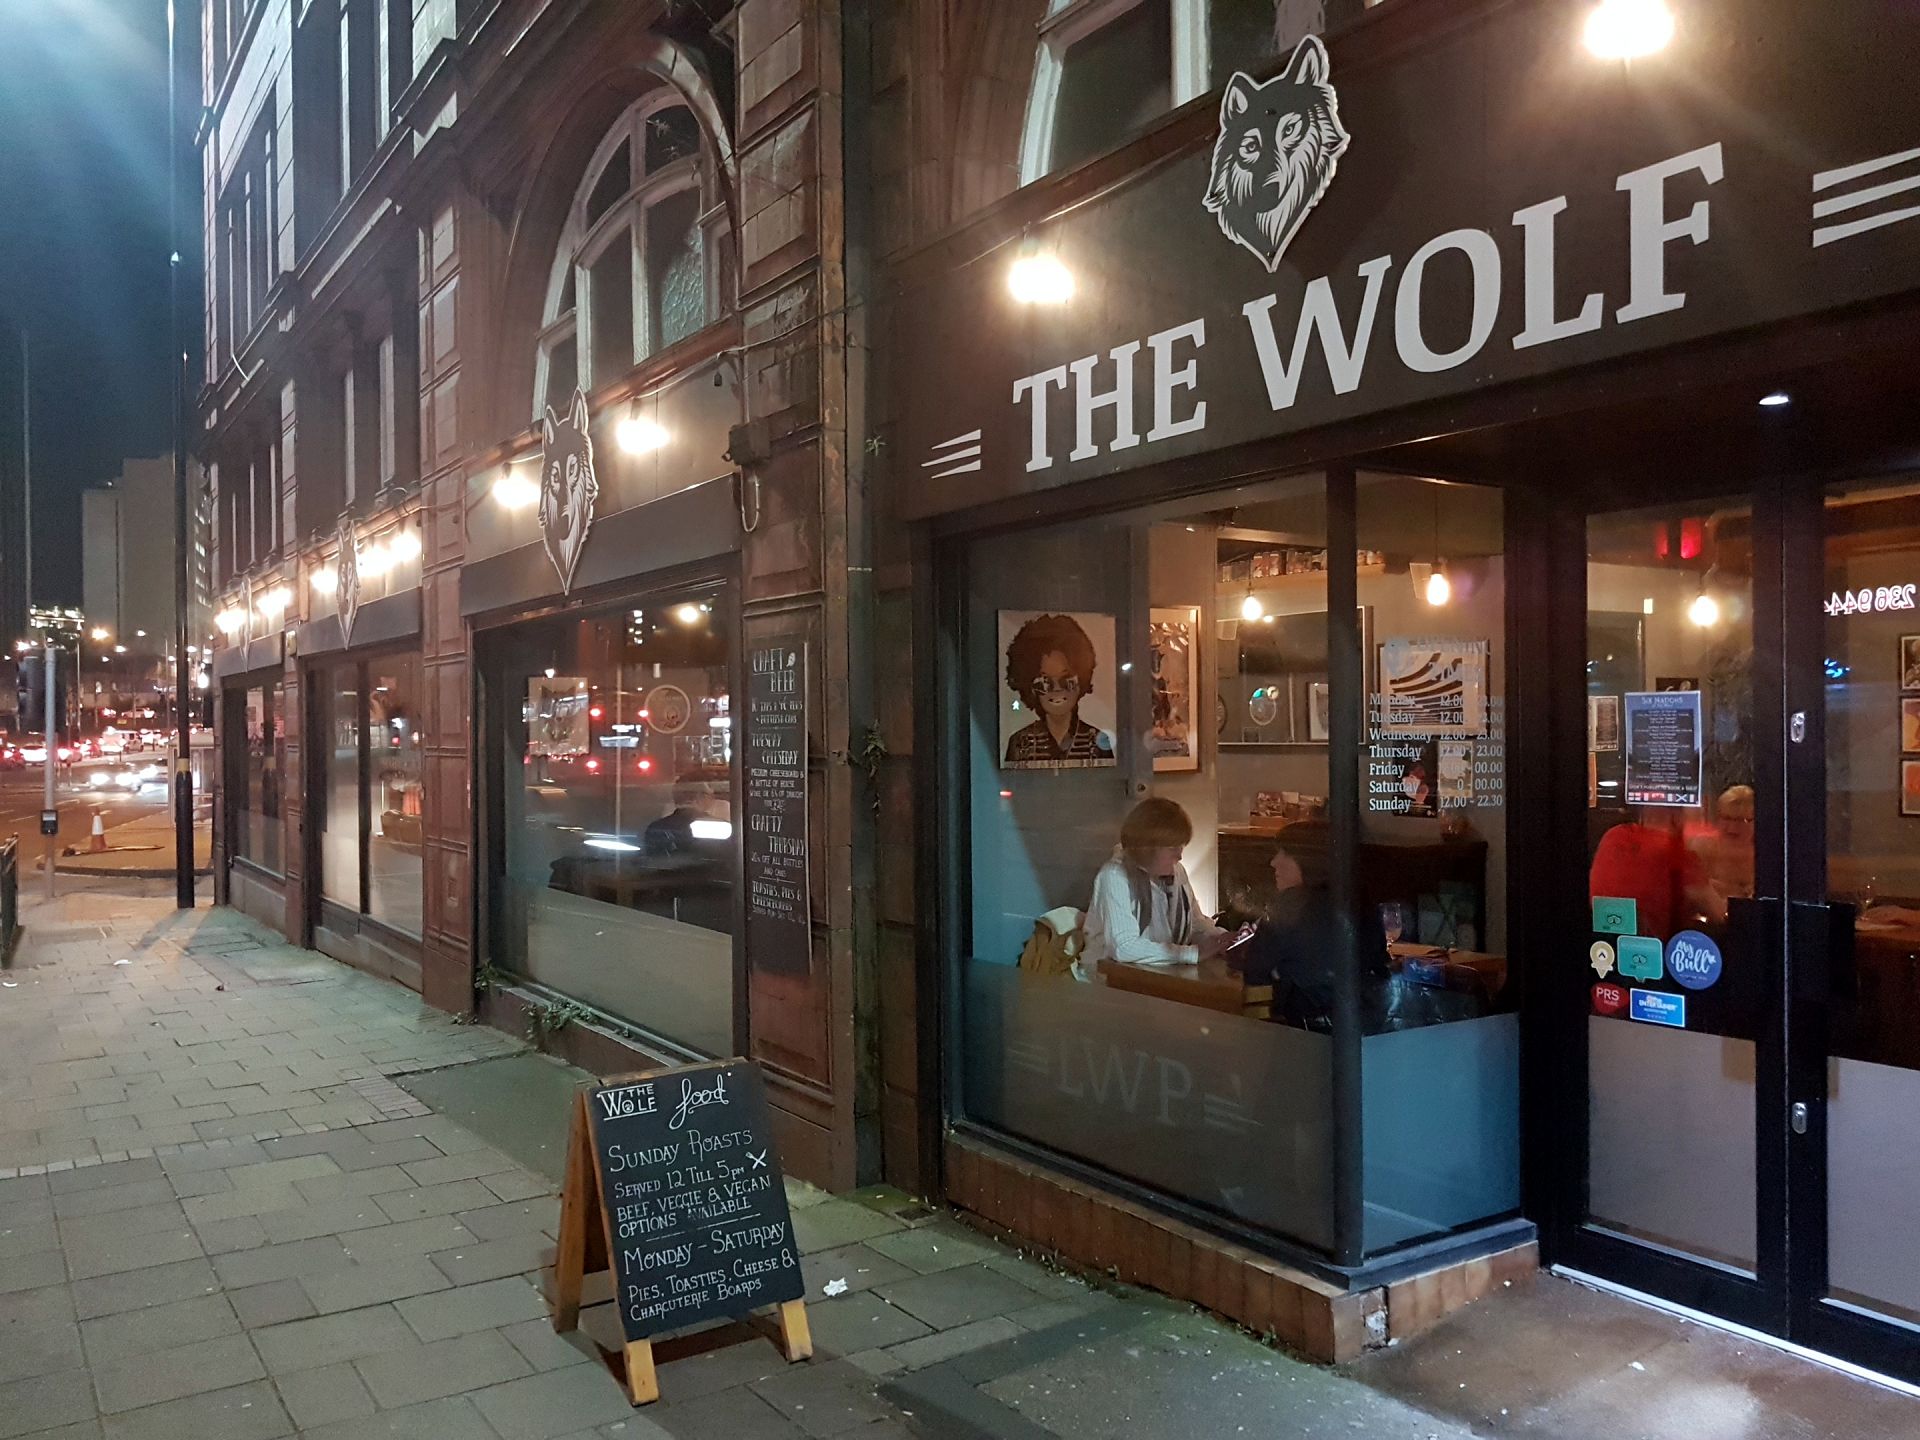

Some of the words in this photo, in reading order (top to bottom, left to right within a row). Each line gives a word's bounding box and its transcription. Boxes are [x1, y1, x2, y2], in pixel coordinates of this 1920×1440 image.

[1012, 318, 1207, 473] THE
[1241, 141, 1725, 411] WOLF
[752, 648, 784, 672] CRAFT
[771, 670, 795, 692] BEER
[1369, 693, 1416, 707] Mnday
[1369, 710, 1415, 724] Tusday
[1369, 727, 1433, 743] Wednesday
[1440, 729, 1466, 740] 12.00
[1369, 744, 1422, 760] Thursday
[1476, 745, 1502, 757] 23.00
[1369, 762, 1405, 778] Friday
[1474, 762, 1503, 773] 00.00
[1369, 779, 1419, 795] Saturday
[1474, 778, 1503, 790] 00.00
[1369, 796, 1411, 812] Sunday
[1440, 796, 1466, 808] 12.00
[1477, 795, 1503, 807] 22.30
[752, 814, 782, 832] CRAFTY
[768, 835, 804, 856] THURSDAY
[1596, 986, 1620, 1001] PRS
[626, 1085, 655, 1098] THE
[668, 1073, 728, 1131] food
[600, 1092, 657, 1117] WOLF
[608, 1143, 680, 1173] SUNDAY
[687, 1129, 753, 1161] ROASTS
[614, 1179, 661, 1199] SERVED
[666, 1171, 685, 1190] 12
[657, 1190, 703, 1213] VEGGIE
[708, 1187, 721, 1203] &
[723, 1175, 771, 1197] VEGAN
[619, 1212, 677, 1239] OPTIONS
[624, 1242, 692, 1275] MONDAY
[711, 1221, 785, 1254] SATURDAY
[733, 1257, 779, 1278] CHEESE
[782, 1248, 796, 1268] &
[630, 1290, 710, 1322] CHARCUTERIE
[717, 1279, 762, 1301] BOARDS
